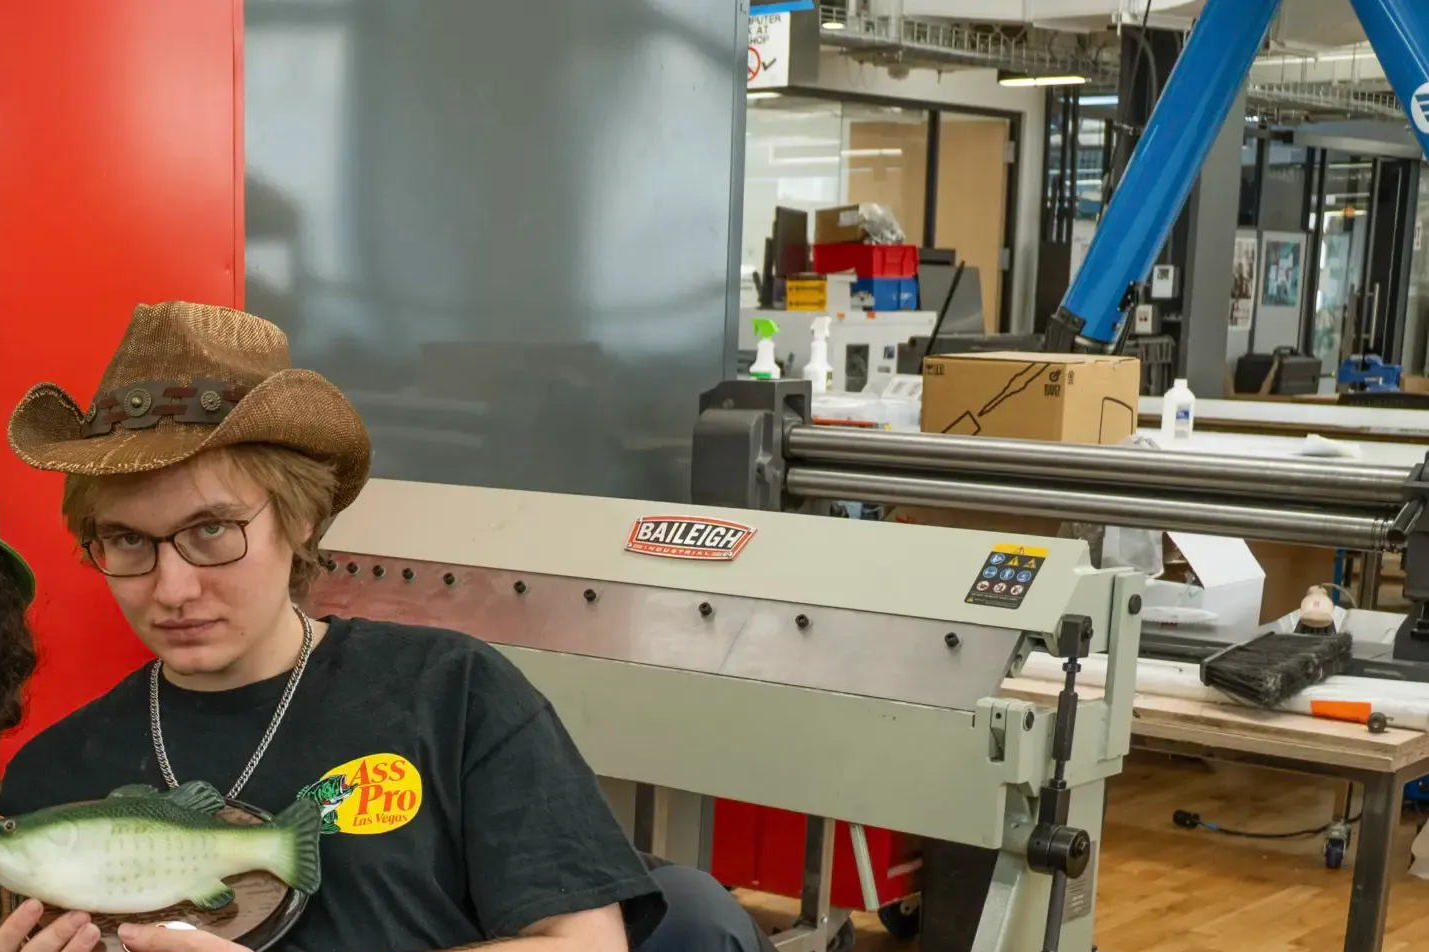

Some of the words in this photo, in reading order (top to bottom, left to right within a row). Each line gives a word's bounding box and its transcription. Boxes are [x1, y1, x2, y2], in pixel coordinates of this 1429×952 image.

[636, 521, 744, 549] BAILEIGH
[643, 544, 710, 556] INDUSTRIAL
[357, 784, 417, 816] Pro
[352, 816, 373, 827] Las
[375, 812, 408, 825] Vegas
